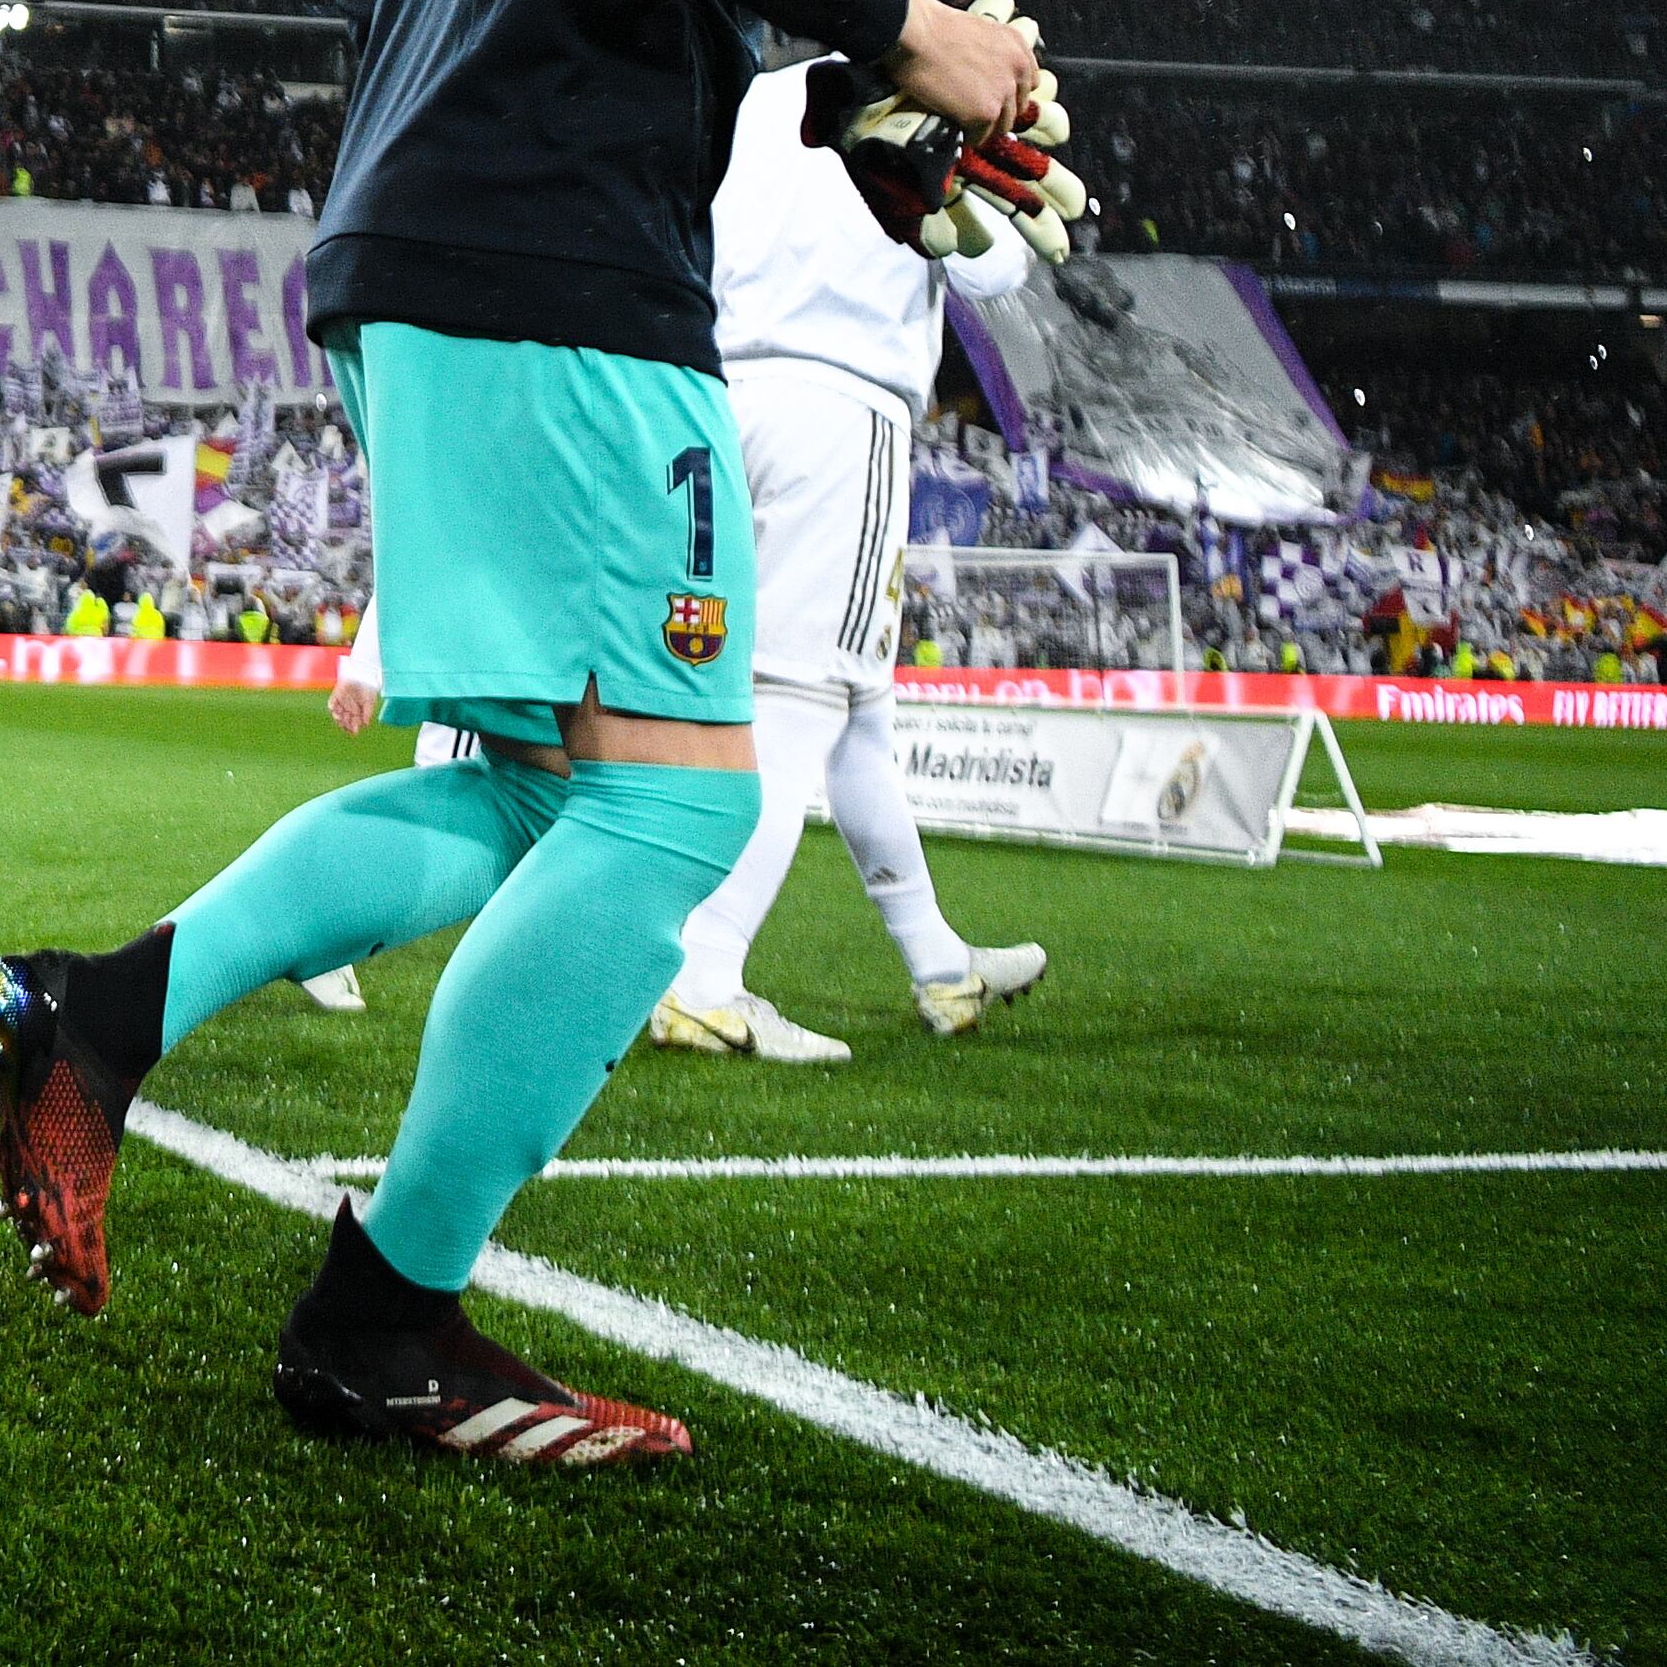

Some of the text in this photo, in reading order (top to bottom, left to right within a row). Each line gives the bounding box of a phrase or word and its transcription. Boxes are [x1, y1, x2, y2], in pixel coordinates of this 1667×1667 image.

[666, 445, 714, 583] 1
[1376, 684, 1525, 725] Emirates
[905, 742, 1056, 789] Madridista
